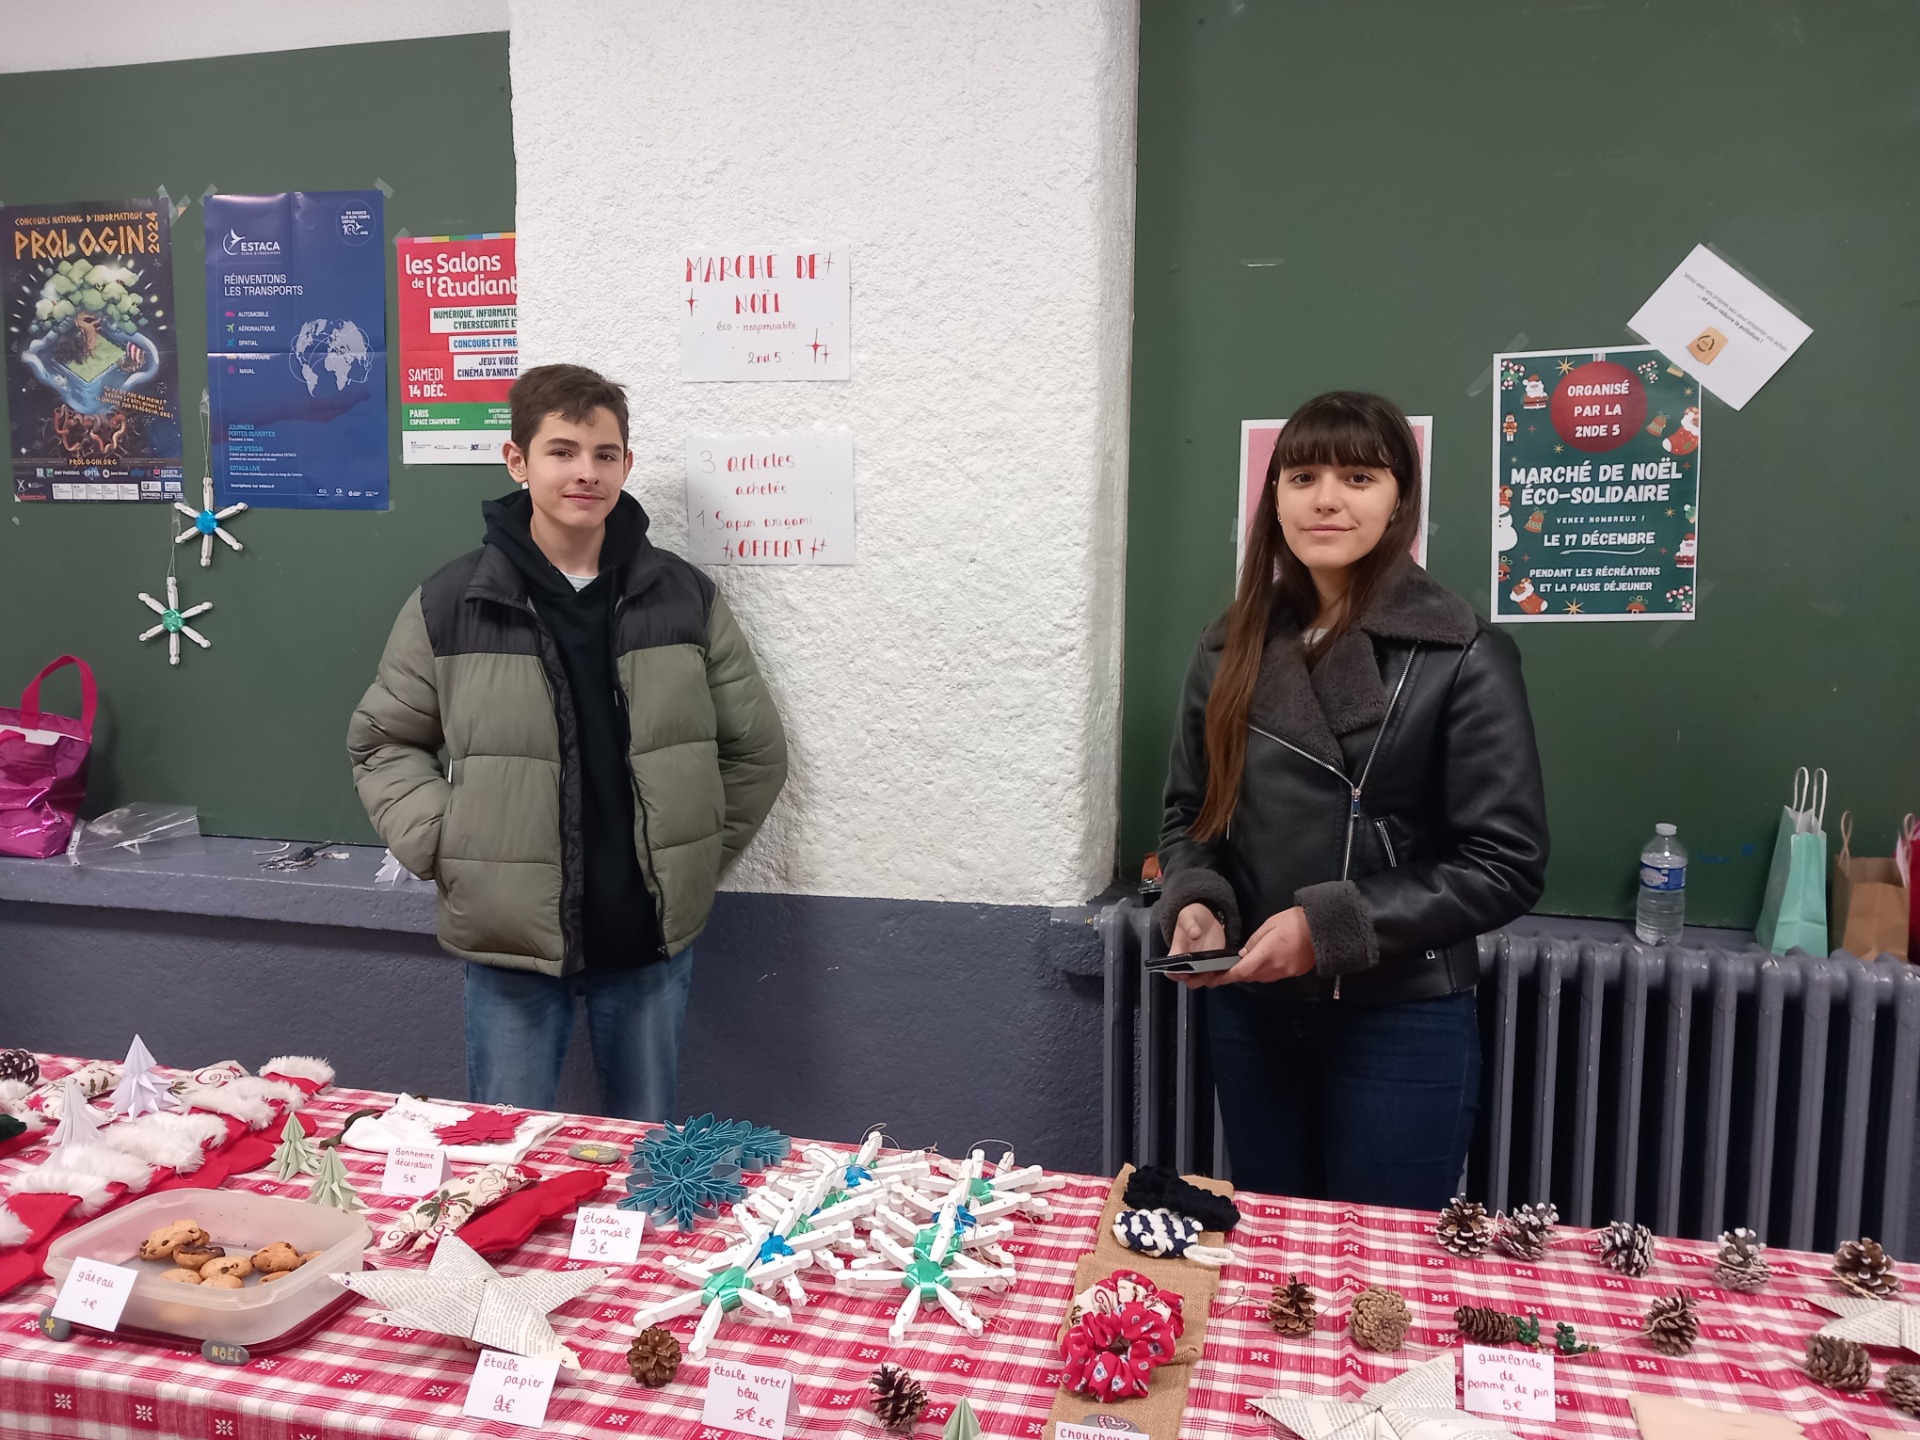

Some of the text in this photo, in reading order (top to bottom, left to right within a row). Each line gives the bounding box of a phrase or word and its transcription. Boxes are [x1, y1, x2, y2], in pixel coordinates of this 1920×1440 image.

[15, 211, 143, 227] CONCOURS NATIONAL D'INFORMATIQUE
[145, 211, 160, 254] 2024
[14, 224, 145, 260] PROLOGIN
[240, 241, 280, 251] ESTACA
[405, 251, 501, 275] les Salons
[796, 252, 821, 280] DE
[224, 273, 287, 285] RÉINVENTONS
[411, 277, 424, 289] de
[224, 285, 303, 296] LES TRANSPORTS
[735, 288, 782, 315] NOËL
[433, 308, 475, 319] NUMÉRIQUE,
[1706, 300, 1719, 311] pour
[1718, 308, 1735, 323] réduire
[1739, 324, 1760, 341] pollution
[454, 317, 509, 330] CYBERSÉCURITÉ
[453, 339, 491, 348] CONCOURS
[492, 338, 501, 347] ET
[478, 357, 497, 366] JEUX
[748, 351, 782, 364] 2nd 5
[408, 368, 444, 382] SAMEDI
[457, 366, 484, 378] CINÉMA
[408, 380, 447, 398] 14 DÉC.
[1567, 379, 1630, 397] ORGANISÉ
[409, 409, 429, 418] PARIS
[1574, 403, 1622, 417] PAR LA
[410, 418, 428, 426] ESPACE
[1575, 424, 1621, 438] 2NDE 5
[69, 458, 118, 466] PROLOGIN.ORG
[699, 450, 795, 474] 3 articles
[1510, 456, 1683, 485] MARCHÉ DE NOËL
[735, 480, 788, 496] achetés
[1521, 483, 1670, 506] ÉCO-SOLIDAIRE
[696, 509, 705, 528] 1
[763, 515, 813, 530] origami
[1556, 516, 1585, 524] VENEZ
[1589, 515, 1637, 523] NOMBREUX
[1543, 530, 1656, 547] LE 17 DÉCEMBRE
[738, 538, 804, 558] OFFERT
[1529, 565, 1661, 578] PENDANT LES RÉCRÉATIONS
[1539, 579, 1653, 592] ET LA PAUSE DÉJEUNER
[395, 1147, 435, 1160] Bonhomme
[395, 1158, 433, 1170] décoration
[403, 1174, 417, 1183] 5€
[579, 1225, 596, 1235] de
[588, 1238, 608, 1254] 3€
[76, 1269, 114, 1289] gâteau
[81, 1297, 98, 1310] 1€
[211, 1344, 241, 1362] NOËL
[484, 1353, 519, 1372] étoile
[1478, 1353, 1544, 1371] guirlande
[714, 1362, 746, 1381] étoile
[1499, 1370, 1517, 1382] de
[503, 1375, 544, 1390] papier
[1467, 1379, 1549, 1400] pomme de pin
[737, 1386, 760, 1402] bleu
[493, 1394, 515, 1413] 2€
[1502, 1399, 1523, 1411] 5€
[758, 1416, 775, 1429] 2€
